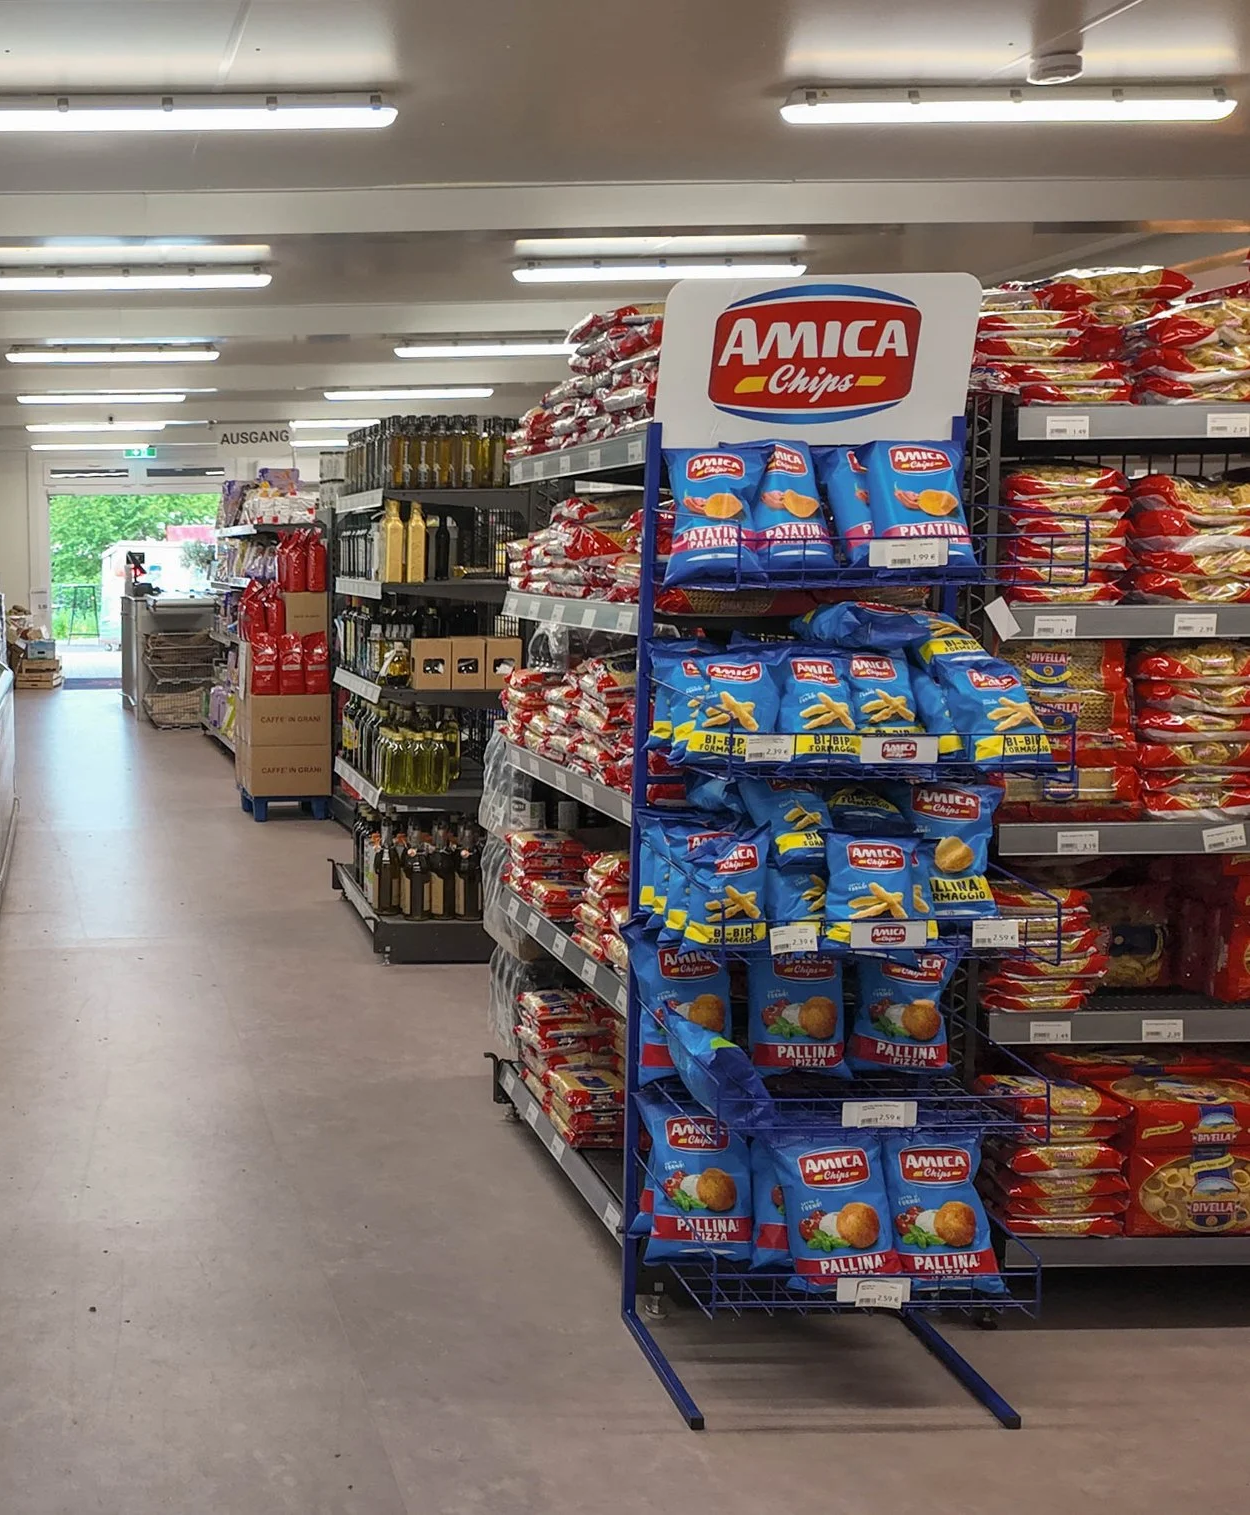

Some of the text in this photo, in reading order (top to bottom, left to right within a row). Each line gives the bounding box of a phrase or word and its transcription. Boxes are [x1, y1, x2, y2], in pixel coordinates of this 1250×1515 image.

[718, 318, 909, 367] AMICA
[768, 364, 855, 403] Chips
[220, 429, 290, 445] AUSGANG
[894, 450, 946, 463] AMICA
[691, 457, 741, 473] AMICA
[900, 523, 966, 537] PATATINA
[690, 538, 738, 550] PAPRIKA
[1031, 652, 1066, 663] DIVELLA
[710, 665, 759, 676] AMICA
[851, 659, 891, 671] AMICA
[882, 743, 917, 754] AMICA
[288, 766, 297, 774] IN
[297, 766, 322, 774] GRANI
[917, 788, 976, 808] AMICA
[933, 803, 961, 815] Chips
[852, 847, 902, 859] AMICA
[866, 857, 890, 868] Chips
[872, 927, 906, 937] AMICA
[680, 964, 703, 975] Chips
[793, 963, 819, 976] Chips
[893, 1057, 926, 1067] PIZZA
[1197, 1133, 1231, 1142] DIVELLA
[805, 1155, 863, 1174] AMICA
[905, 1154, 966, 1169] AMICA
[823, 1171, 850, 1182] Chips
[924, 1168, 952, 1180] Chips
[1192, 1202, 1234, 1213] DIVELLA
